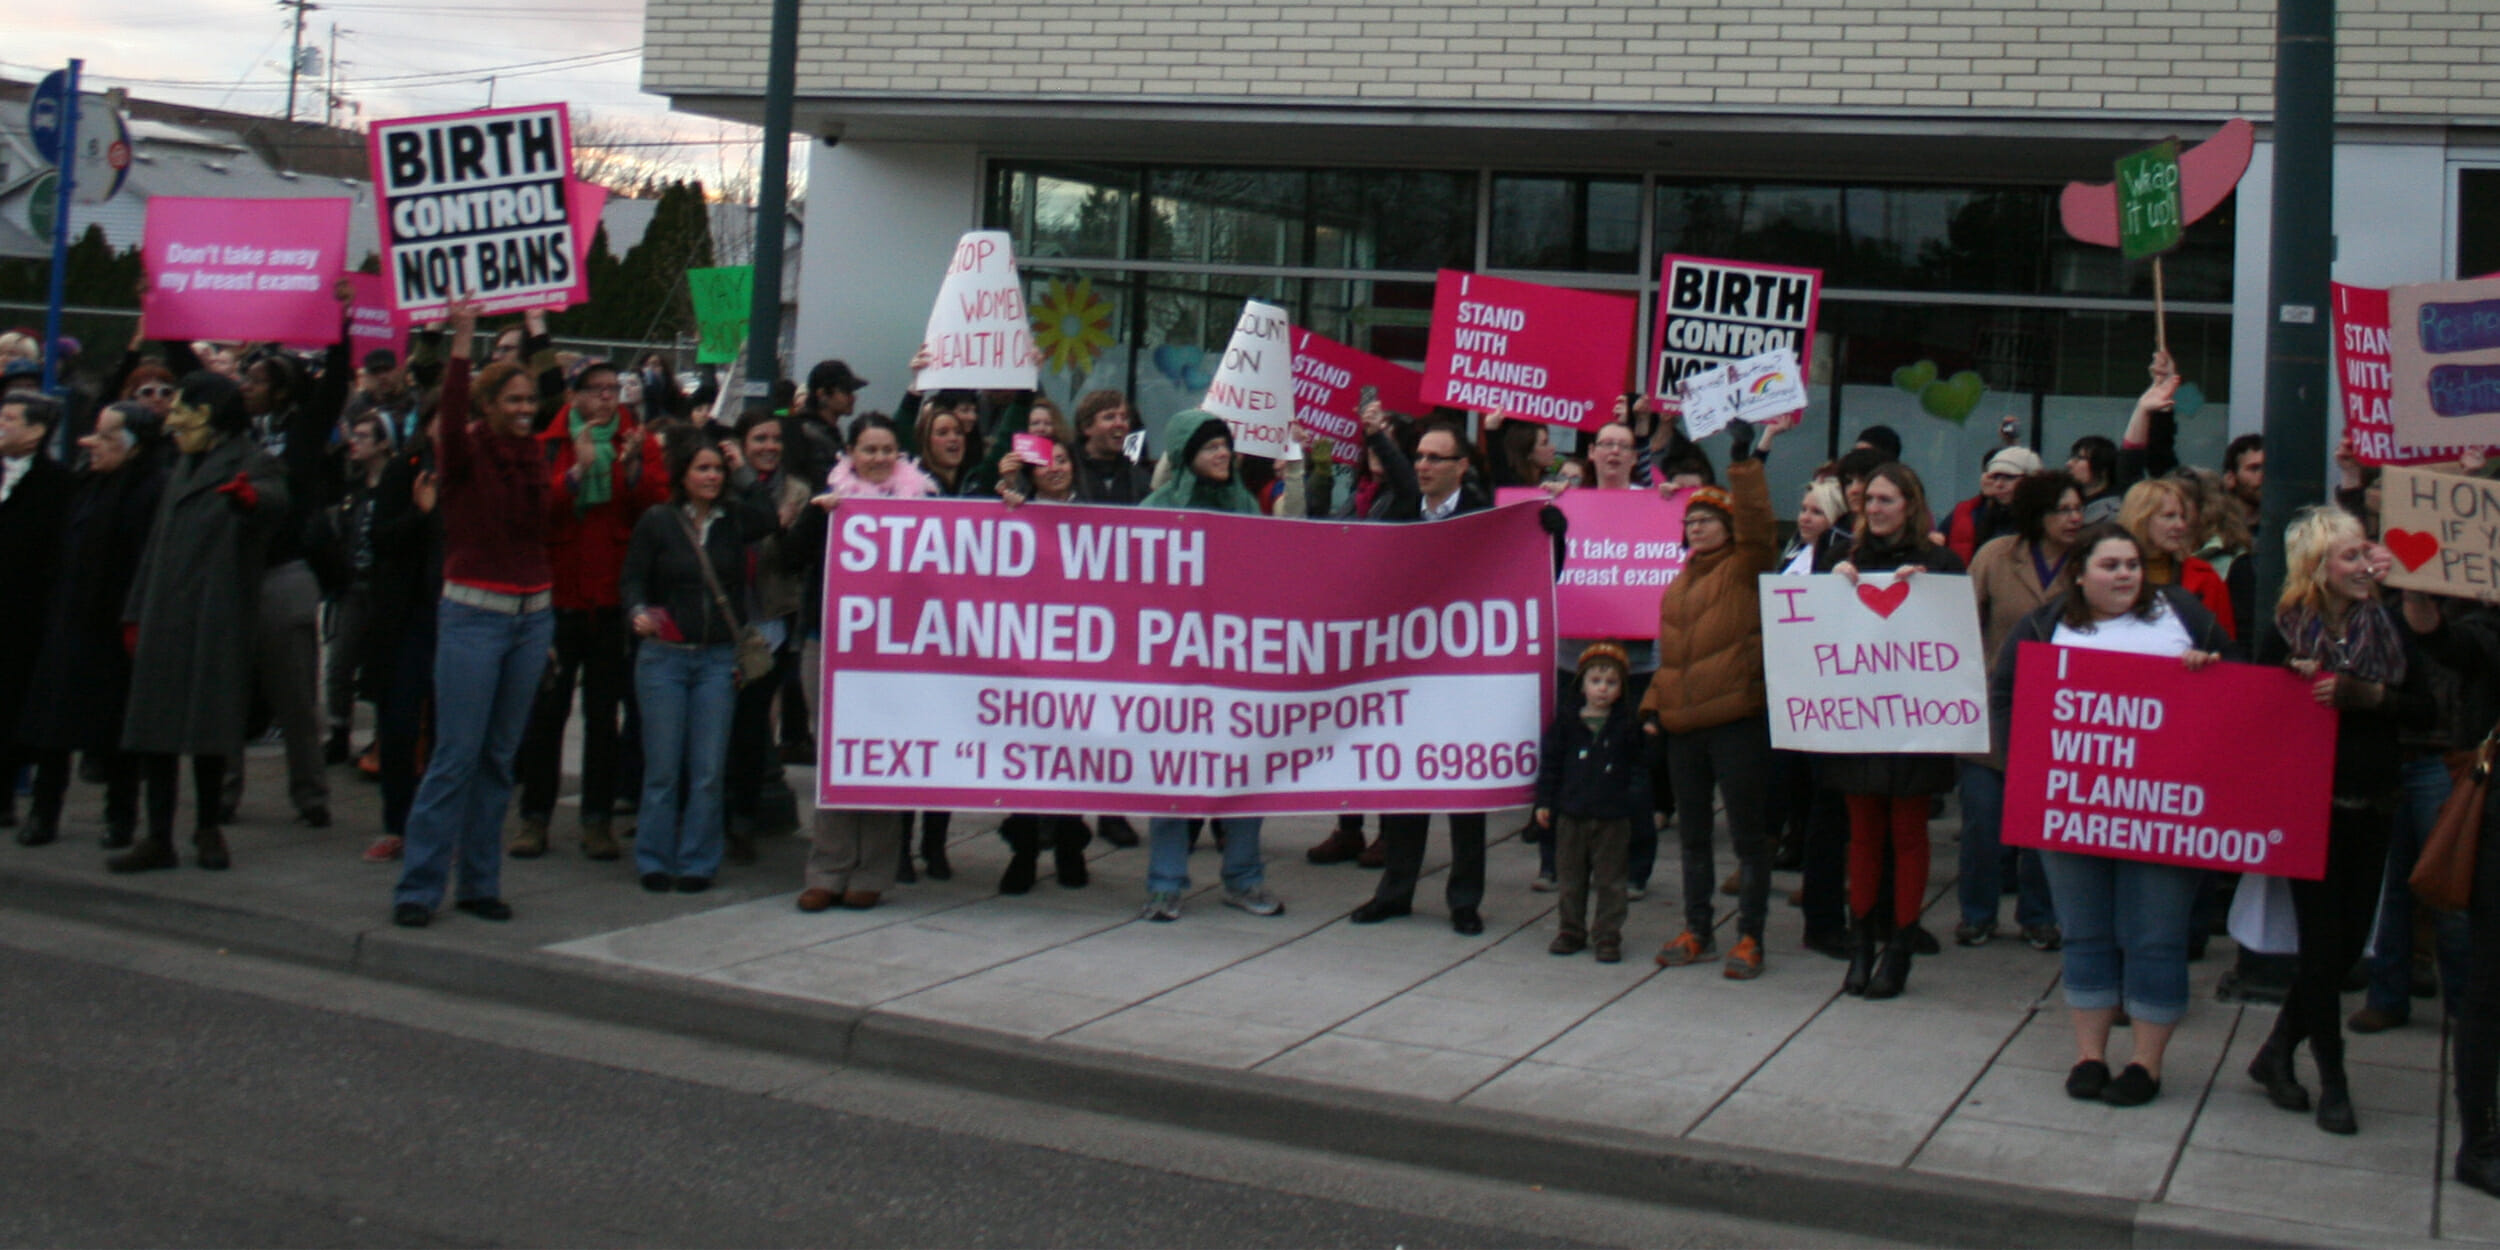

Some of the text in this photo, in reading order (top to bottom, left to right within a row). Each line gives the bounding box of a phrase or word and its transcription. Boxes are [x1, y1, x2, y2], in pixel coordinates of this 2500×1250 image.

[386, 117, 557, 188] BIRTH
[393, 184, 565, 239] CONTROL
[2126, 201, 2142, 236] it
[166, 242, 321, 269] Don't take away
[399, 232, 570, 302] NOT BANS
[158, 270, 322, 293] my breast exams
[1460, 275, 1470, 296] I
[1672, 266, 1808, 322] BIRTH
[1457, 301, 1525, 332] STAND
[2341, 287, 2348, 315] I
[1299, 332, 1312, 350] I
[1455, 328, 1508, 355] WITH
[1225, 348, 1262, 374] ON
[1291, 354, 1352, 389] STAND
[1450, 354, 1548, 390] PLANNED
[2442, 520, 2464, 541] IF
[839, 514, 1205, 587] STAND WITH
[1583, 538, 1628, 559] take
[1773, 588, 1815, 623] I
[837, 595, 1541, 675] PLANNED PARENTHOOD!
[1813, 641, 1960, 677] PLANNED
[2057, 648, 2069, 681] I
[977, 687, 1410, 739] SHOW YOUR SUPPORT
[1785, 693, 1981, 733] PARENTHOOD
[2052, 688, 2164, 731] STAND
[836, 738, 939, 778] TEXT
[1002, 742, 1133, 784] STAND
[1150, 749, 1249, 788] WITH
[1351, 743, 1402, 782] TO
[1415, 740, 1538, 781] 69866
[2051, 728, 2136, 769] WITH
[2046, 769, 2205, 817] PLANNED
